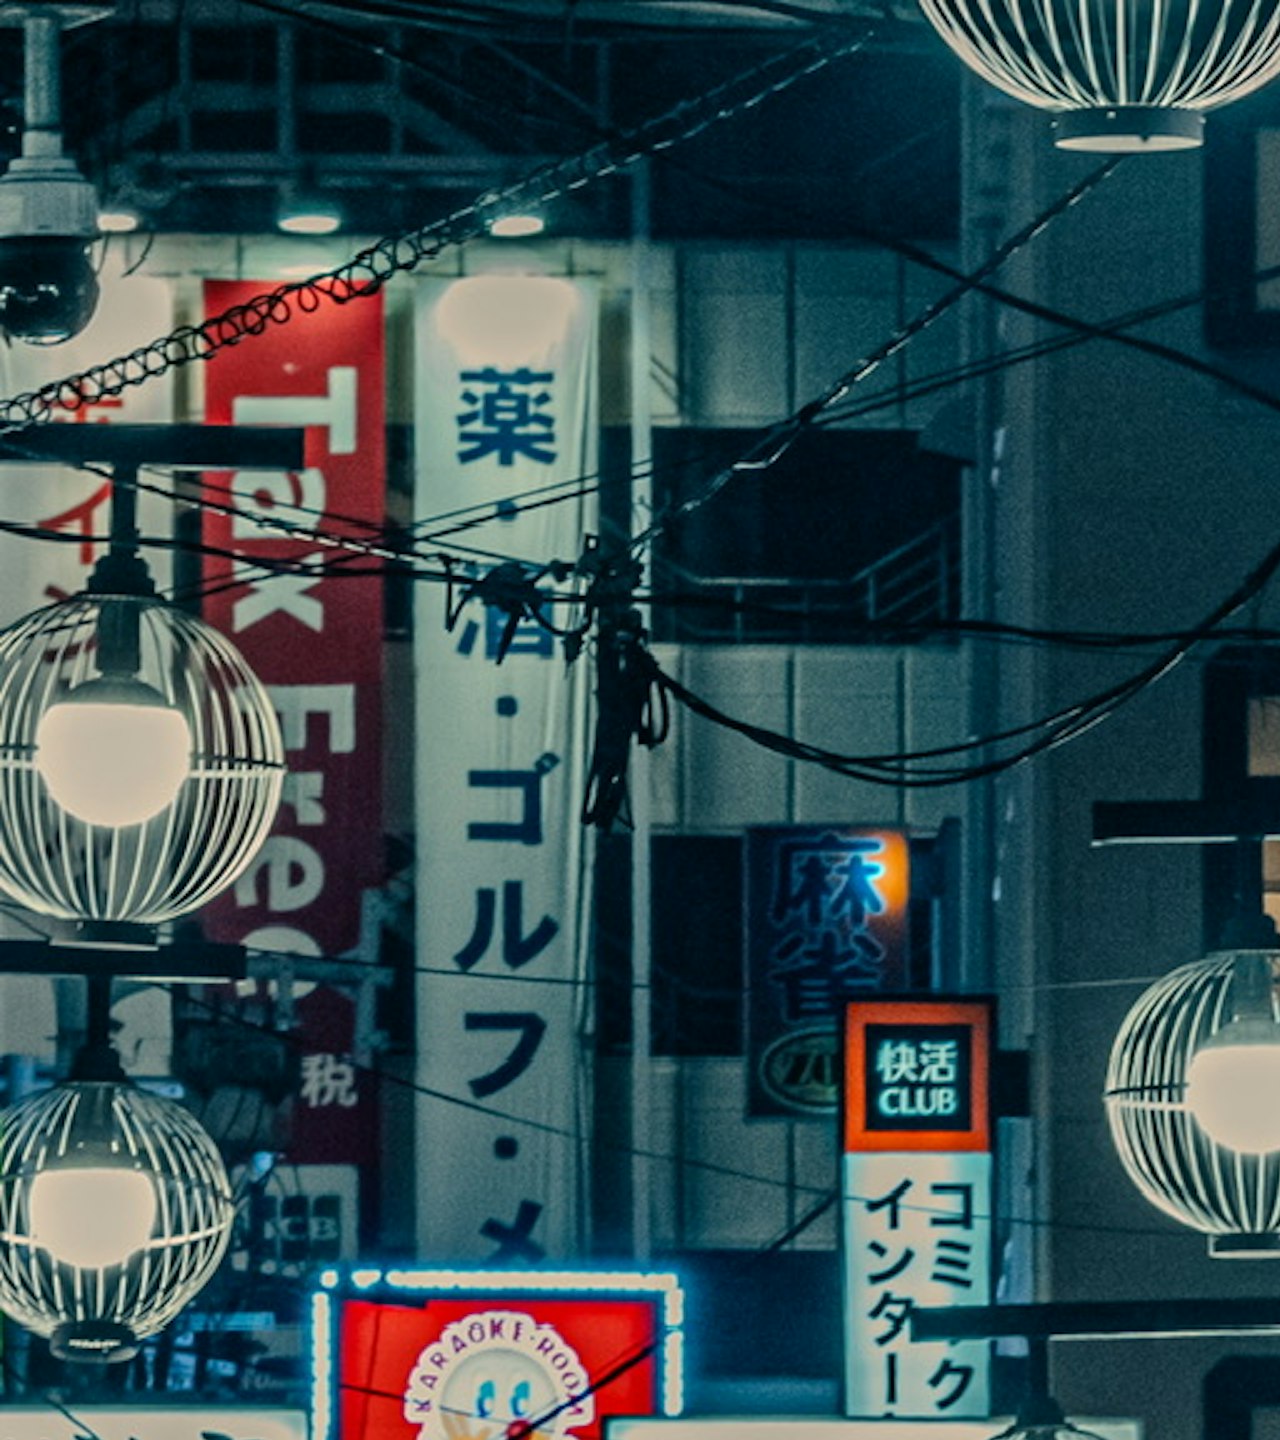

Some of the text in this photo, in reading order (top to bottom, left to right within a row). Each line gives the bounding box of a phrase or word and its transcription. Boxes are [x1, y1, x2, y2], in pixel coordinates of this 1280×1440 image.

[878, 1040, 958, 1085] 快活
[878, 1087, 958, 1116] CLUB
[864, 1179, 915, 1417] インター
[930, 1183, 976, 1411] コミク
